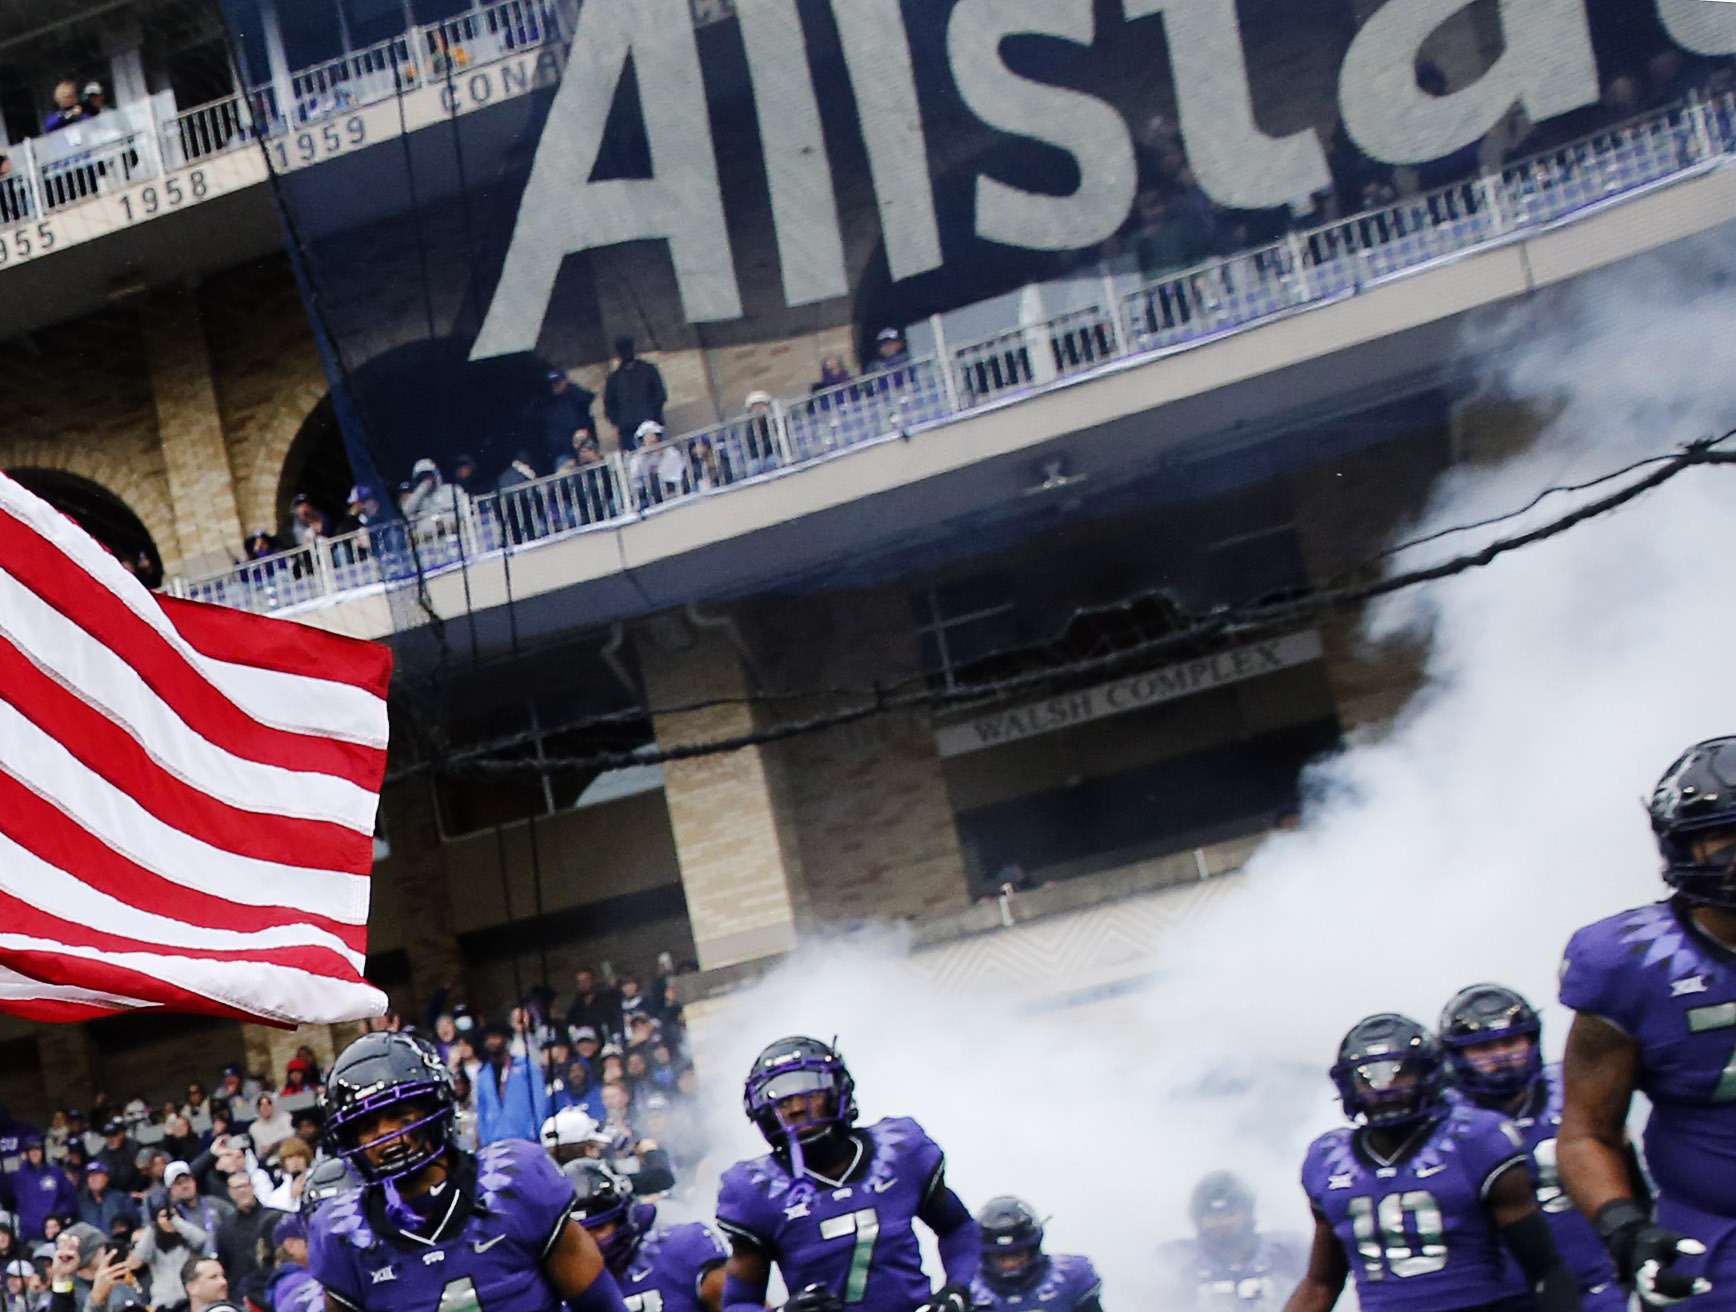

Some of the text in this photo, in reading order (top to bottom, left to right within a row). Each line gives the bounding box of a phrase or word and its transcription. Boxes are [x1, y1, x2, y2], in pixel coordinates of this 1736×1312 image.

[275, 117, 367, 167] 1959
[468, 0, 1736, 361] Allsta
[119, 171, 208, 221] 1958
[1106, 640, 1282, 708] COMPLEX
[820, 1207, 879, 1303] 7
[1347, 1190, 1447, 1280] 10
